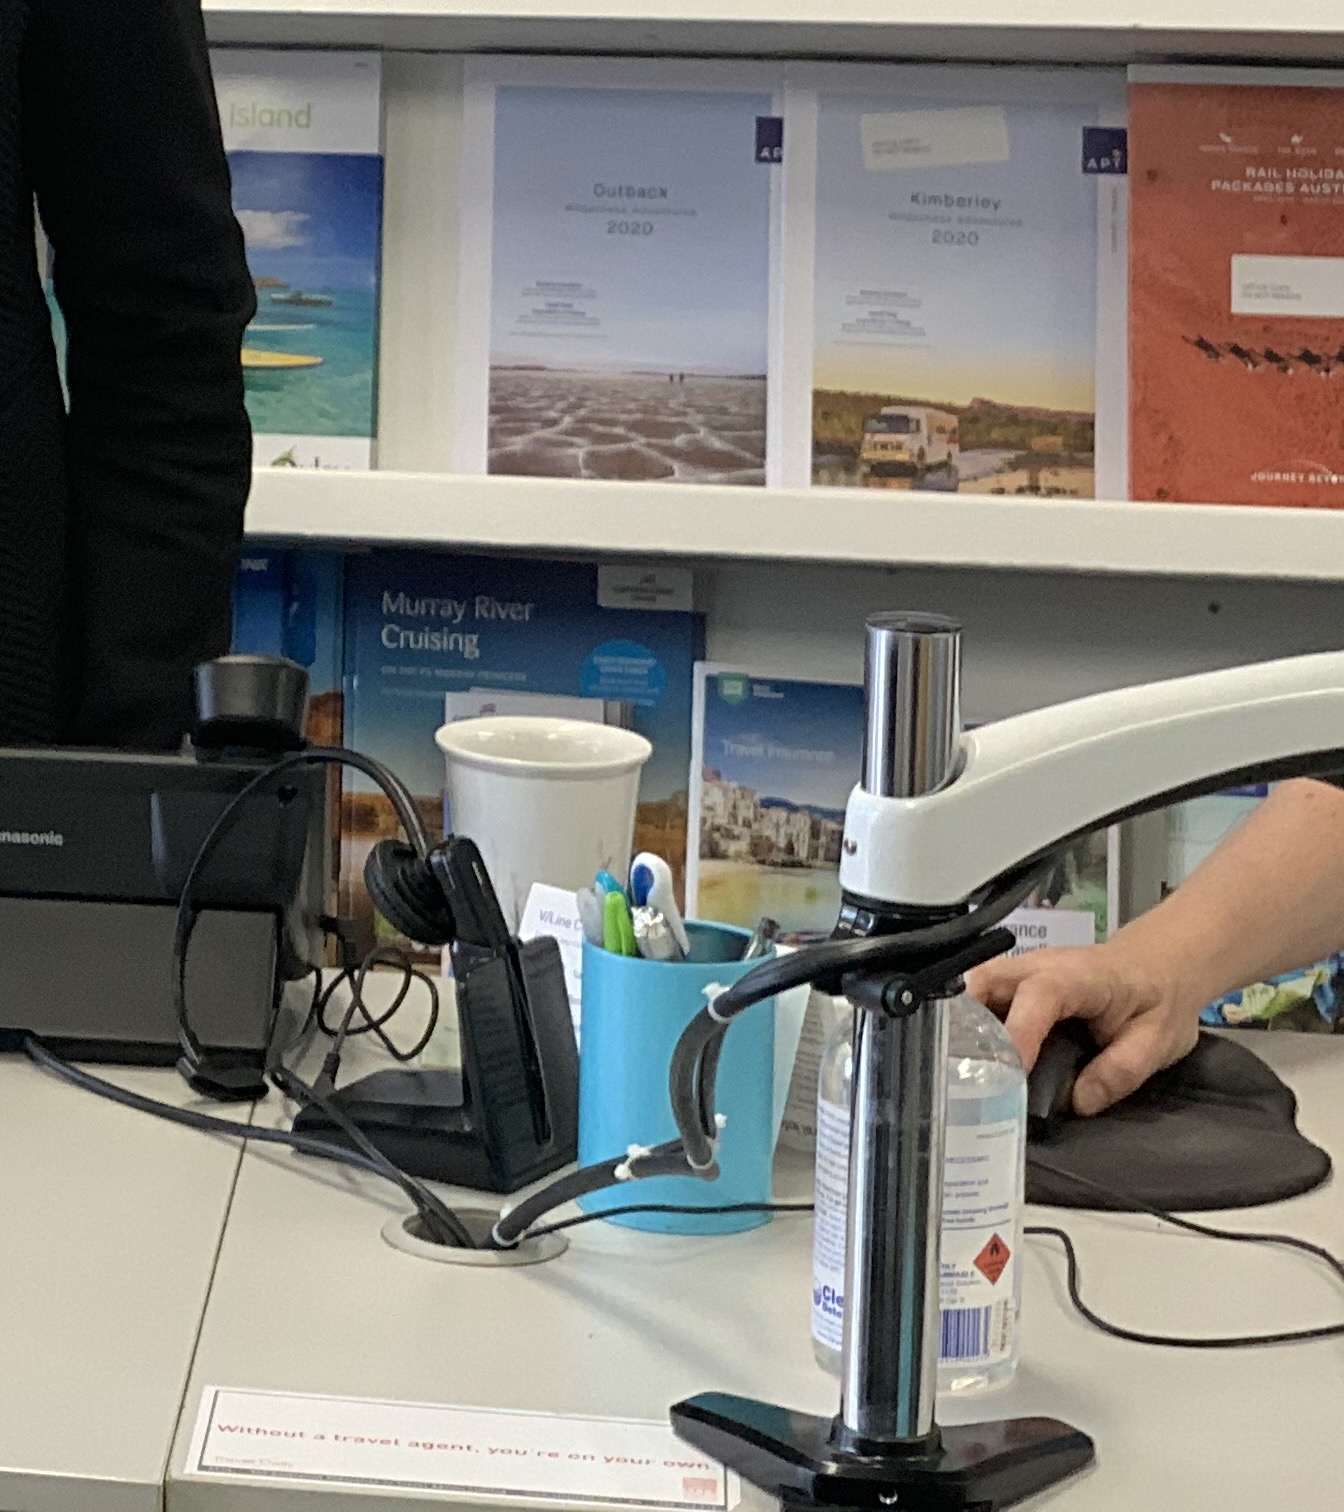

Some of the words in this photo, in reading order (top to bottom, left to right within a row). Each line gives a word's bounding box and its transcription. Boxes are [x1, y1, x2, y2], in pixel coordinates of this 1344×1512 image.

[1245, 167, 1281, 178] RAIL
[593, 183, 669, 200] Outback
[1211, 180, 1295, 193] PACKAGES
[910, 193, 1002, 211] Kimberley
[606, 221, 654, 235] 2020
[931, 230, 979, 246] 2020
[381, 591, 466, 621] Murray
[475, 595, 535, 622] River
[381, 624, 480, 659] Cruising
[217, 1423, 307, 1440] Without
[314, 1433, 326, 1442] a
[334, 1434, 399, 1447] travel
[407, 1440, 480, 1455] agent,
[488, 1446, 563, 1460] you're
[567, 1453, 595, 1462] on
[602, 1454, 657, 1468] your
